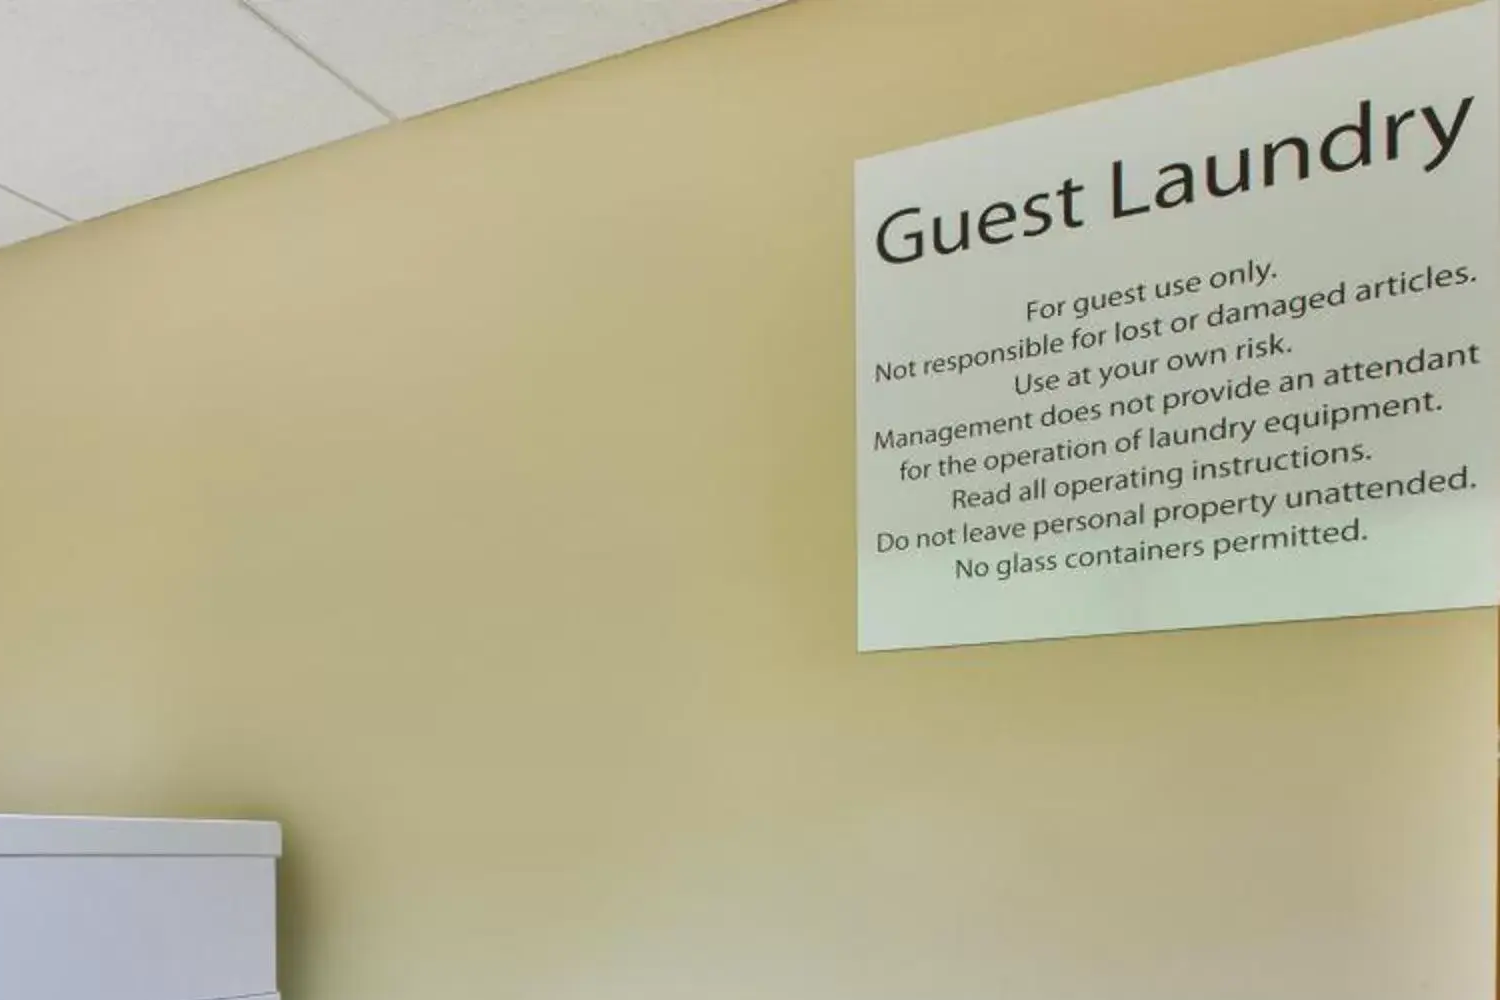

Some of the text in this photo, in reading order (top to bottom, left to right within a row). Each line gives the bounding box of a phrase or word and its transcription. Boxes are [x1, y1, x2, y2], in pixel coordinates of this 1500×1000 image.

[876, 96, 1474, 264] Guest Laundry
[876, 266, 1476, 382] Not responsible for lost or damaged articles.
[1027, 259, 1277, 322] For guest use only.
[874, 344, 1479, 450] Management does not provide an attendant
[1015, 333, 1291, 395] Use at your own risk.
[900, 392, 1442, 480] for the operation of laundry equipment.
[953, 444, 1371, 509] Read all operating instructions.
[878, 465, 1476, 553] Do not leave personal property unattended.
[956, 517, 1367, 580] No glass containers permitted.
